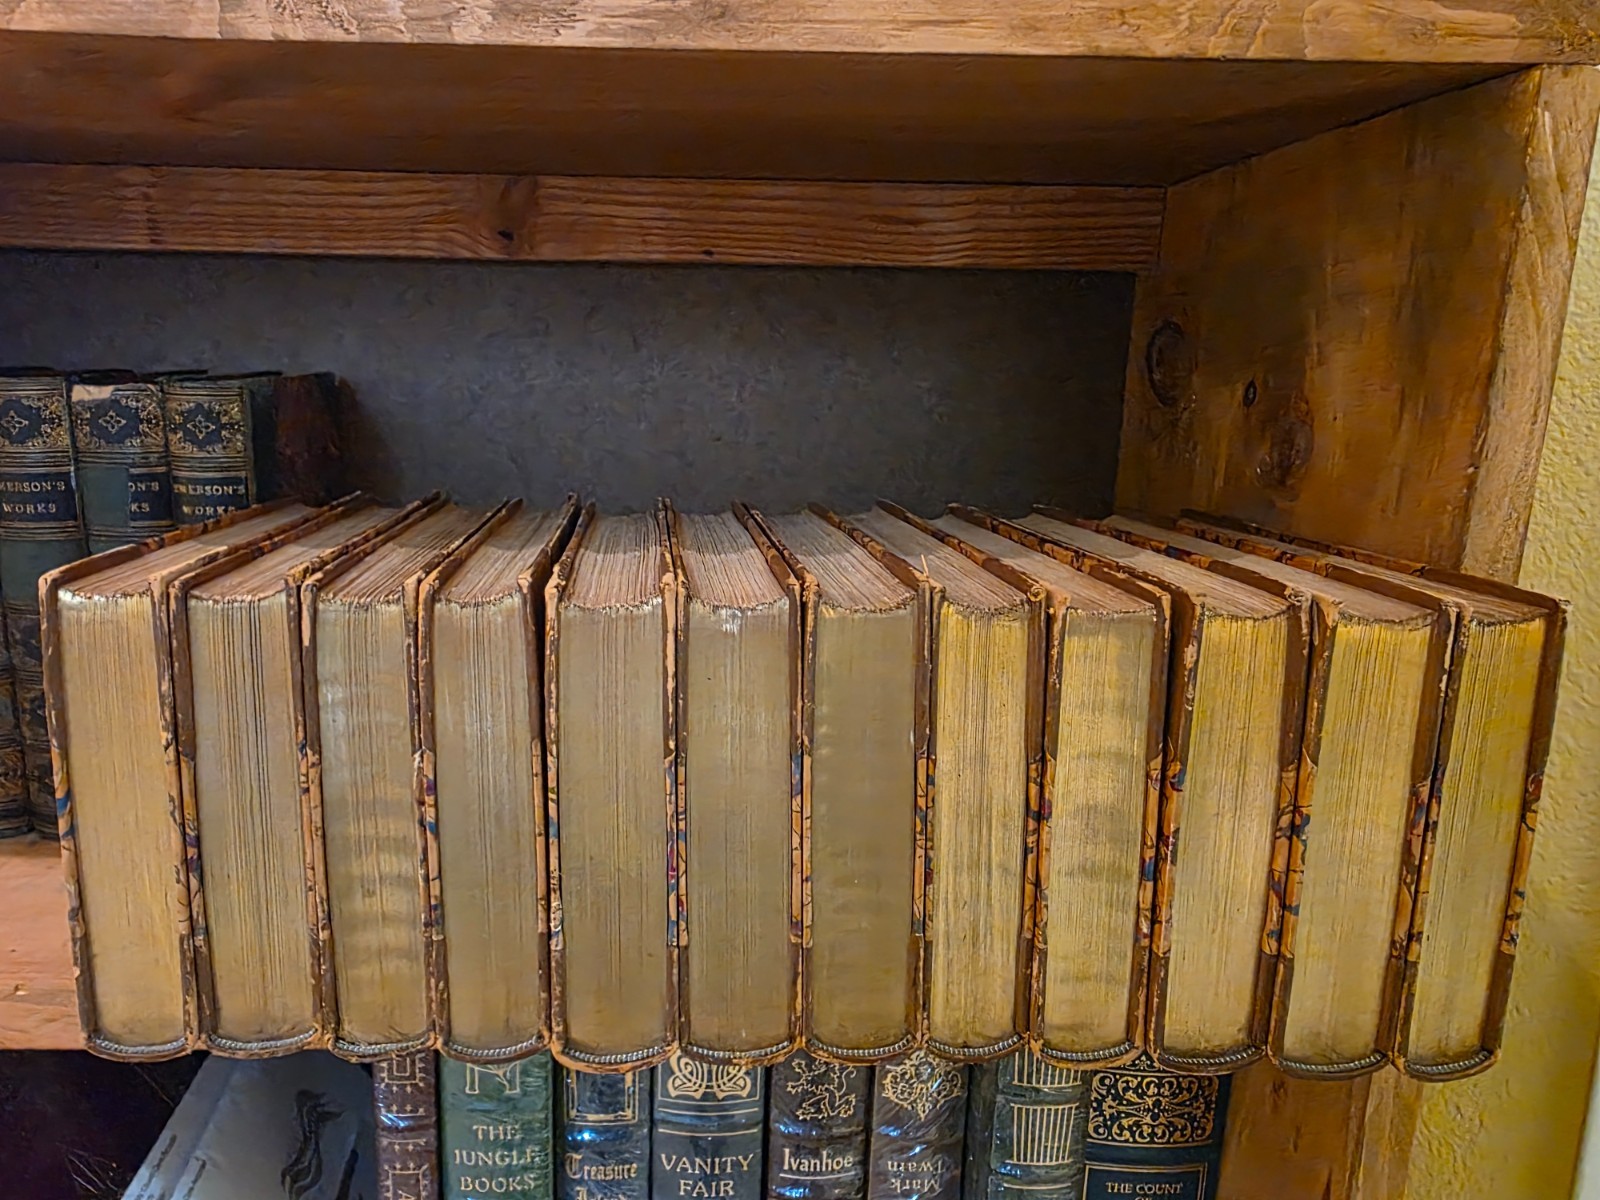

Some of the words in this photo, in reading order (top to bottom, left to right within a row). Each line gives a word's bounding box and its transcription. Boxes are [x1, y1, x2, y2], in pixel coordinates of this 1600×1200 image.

[2, 502, 56, 514] WORKS
[472, 1124, 523, 1141] THE
[564, 1152, 639, 1180] Treasure
[660, 1152, 755, 1175] VANITY
[782, 1147, 855, 1172] Ivanhoe
[887, 1158, 948, 1174] Twain
[460, 1174, 536, 1193] BOOKS
[679, 1178, 736, 1198] FAIR
[889, 1178, 944, 1197] Mark
[1105, 1182, 1133, 1193] THE
[1135, 1182, 1184, 1194] COUNT
